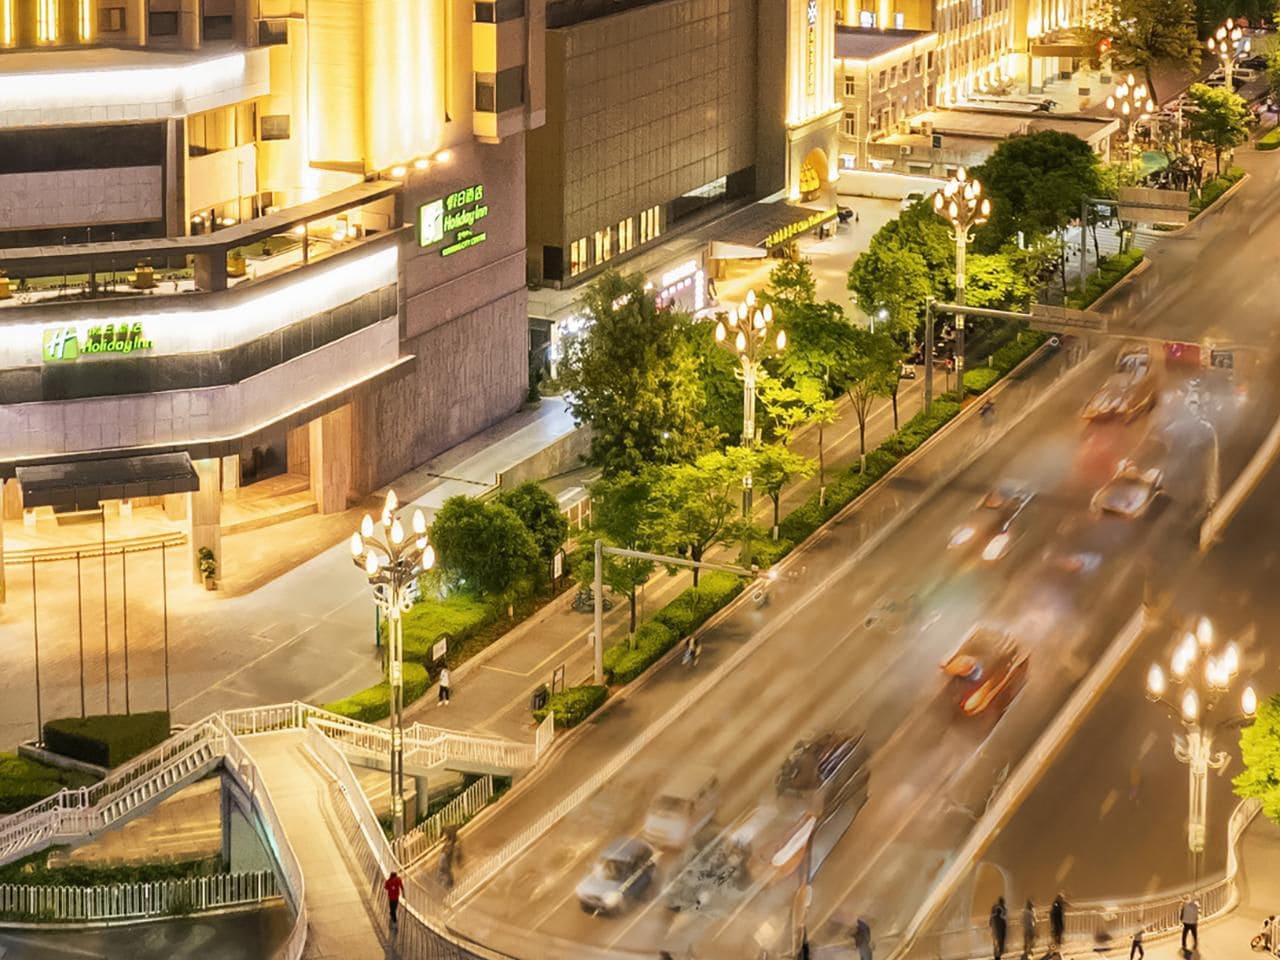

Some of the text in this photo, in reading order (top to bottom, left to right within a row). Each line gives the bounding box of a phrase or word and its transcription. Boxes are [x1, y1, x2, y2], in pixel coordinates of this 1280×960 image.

[443, 204, 488, 232] Holiday Inn
[81, 335, 154, 354] Holiday Inn
